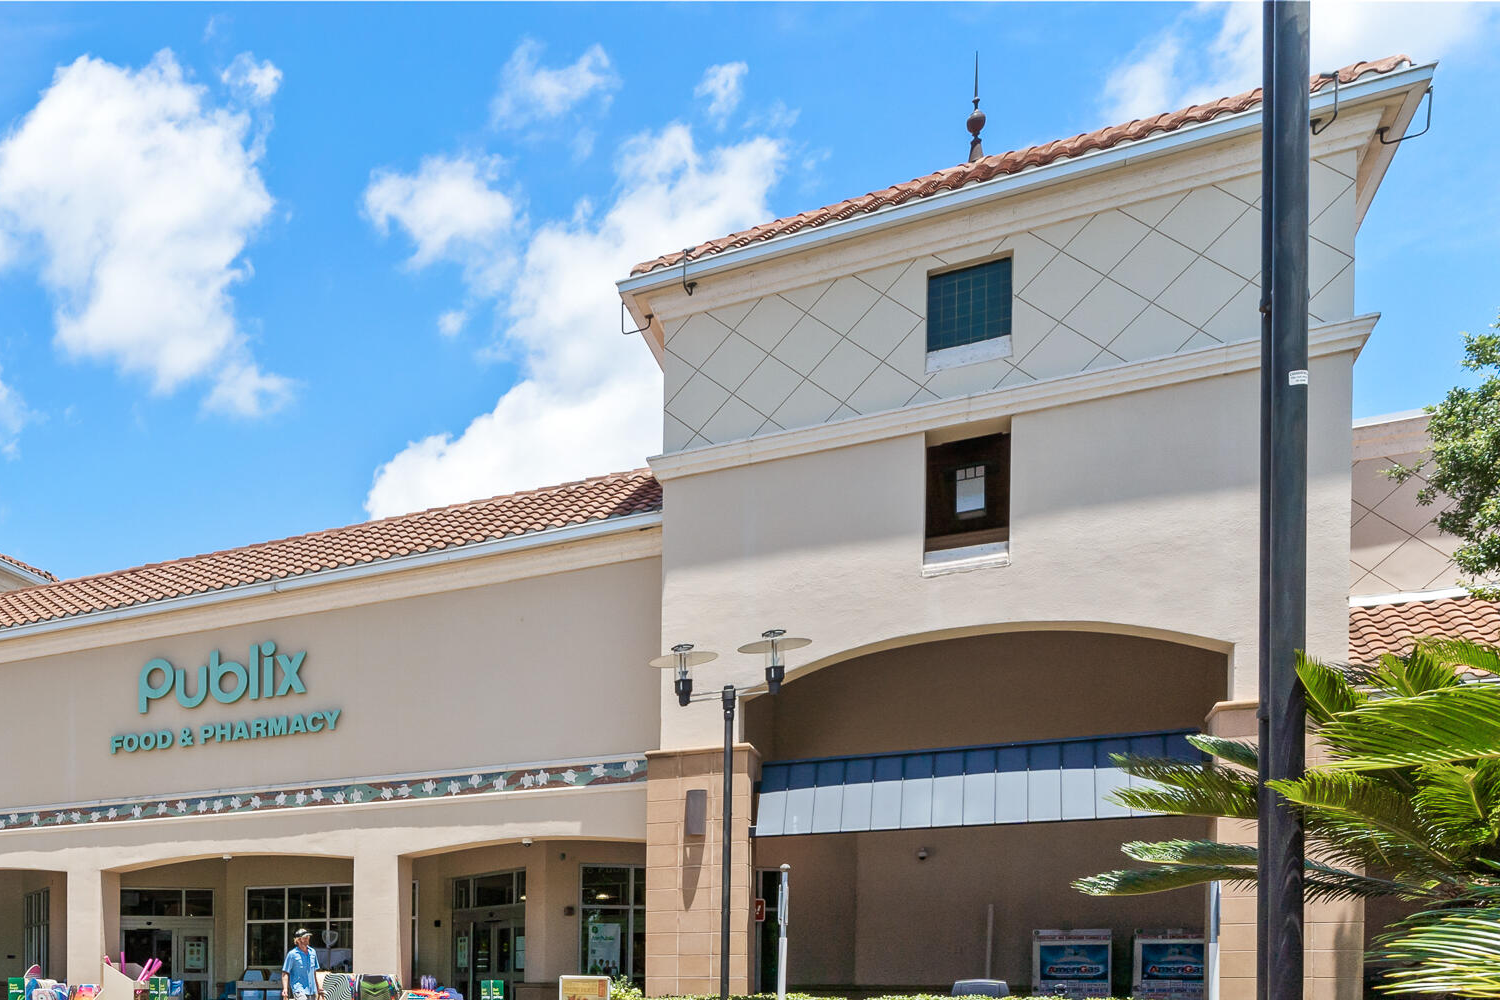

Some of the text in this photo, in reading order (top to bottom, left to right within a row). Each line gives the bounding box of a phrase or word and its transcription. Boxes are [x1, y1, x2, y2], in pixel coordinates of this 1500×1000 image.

[138, 641, 308, 713] Publix
[110, 709, 342, 754] FOOD & PHARMACY
[1047, 965, 1101, 975] AmeriGas
